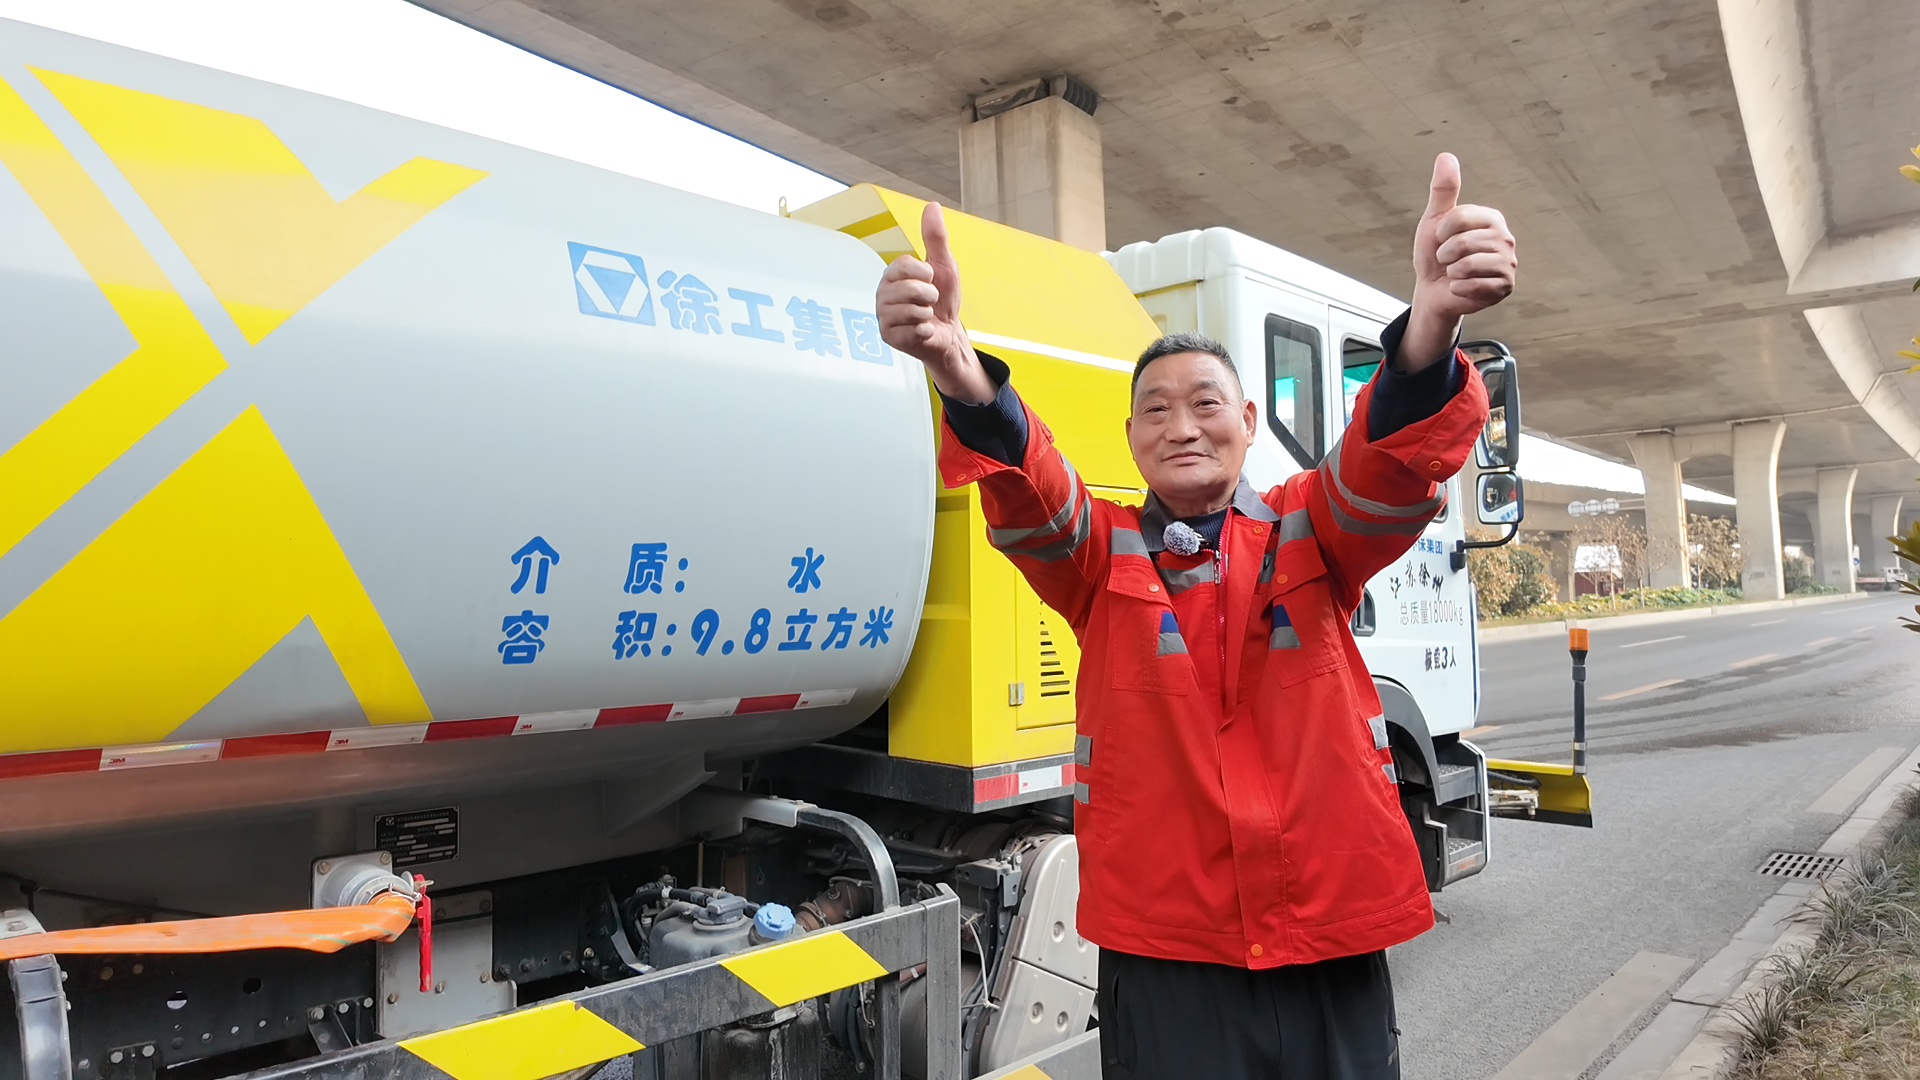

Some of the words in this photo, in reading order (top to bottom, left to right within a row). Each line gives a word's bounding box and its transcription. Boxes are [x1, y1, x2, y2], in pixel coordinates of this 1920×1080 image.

[657, 269, 893, 366] 徐工集团
[1413, 537, 1443, 554] 保集团
[510, 536, 560, 594] 介
[787, 547, 825, 593] 水
[1390, 560, 1444, 600] 江苏徐州
[1400, 600, 1463, 627] 总质量18000kg
[498, 609, 550, 664] 容
[334, 738, 349, 746] 3M
[108, 757, 126, 765] 3M
